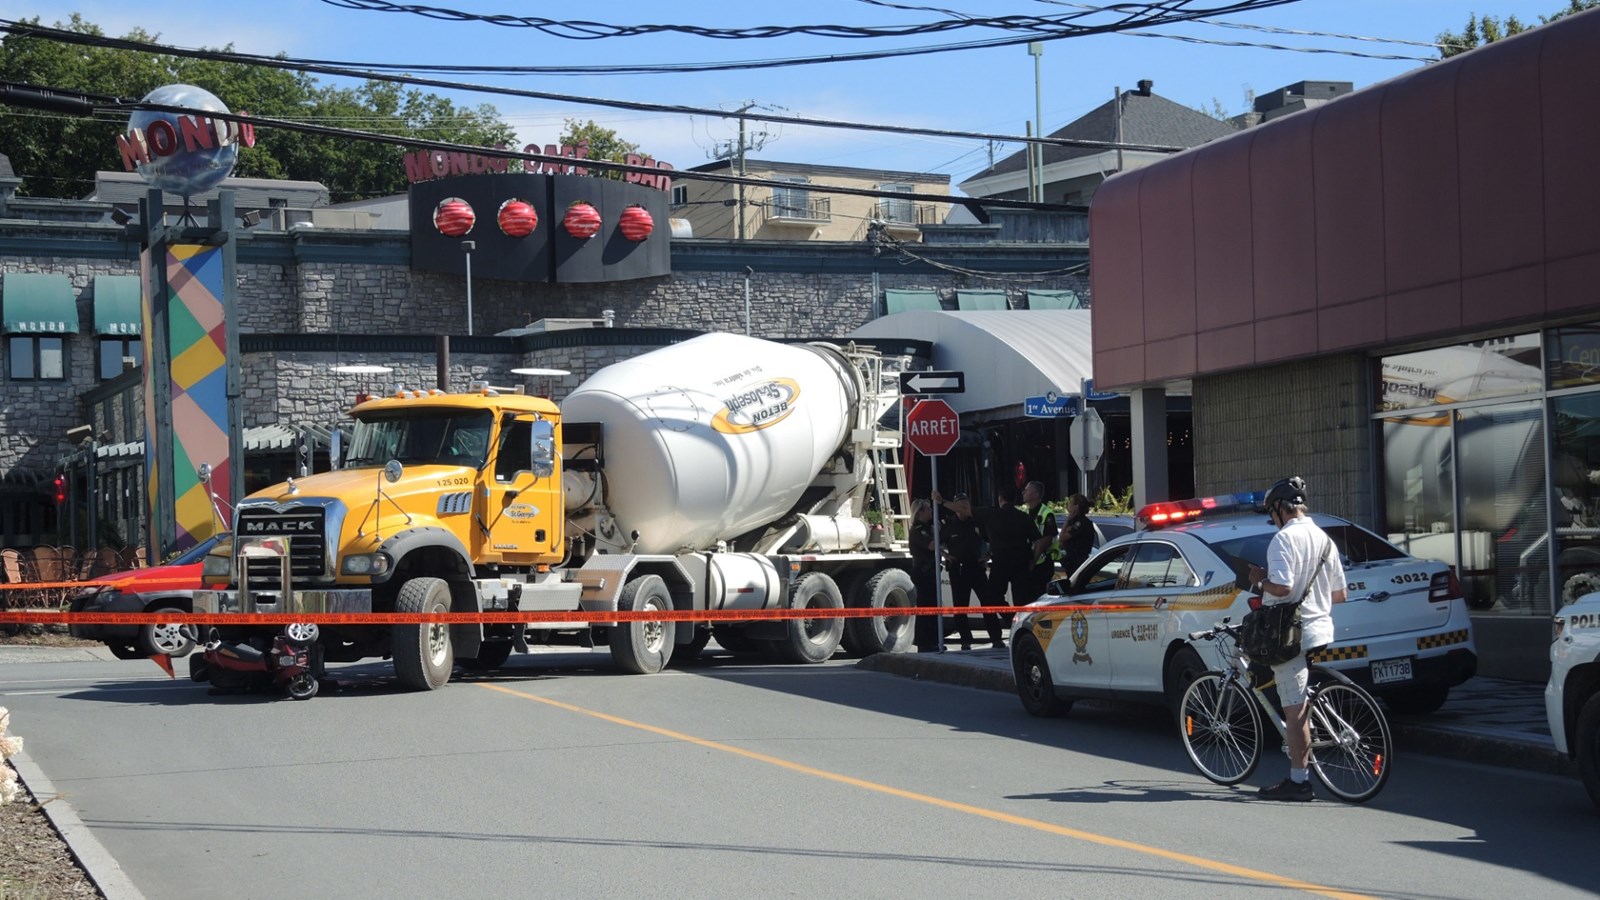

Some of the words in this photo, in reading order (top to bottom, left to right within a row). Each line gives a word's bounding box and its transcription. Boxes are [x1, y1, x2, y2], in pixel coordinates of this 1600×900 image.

[116, 111, 256, 171] MONDO
[404, 144, 508, 183] MONDO
[523, 140, 589, 175] CAFÉ
[625, 154, 673, 192] BAR
[18, 321, 65, 332] MONDO
[109, 322, 141, 333] MON
[1569, 344, 1600, 368] Cen
[752, 401, 788, 423] BETON
[1027, 404, 1038, 414] 1re
[1040, 404, 1076, 414] Avenue
[910, 416, 956, 436] ARRÊT
[246, 521, 315, 531] MACK
[1395, 572, 1429, 585] 3022
[1347, 581, 1366, 591] CE
[1570, 614, 1600, 628] POL
